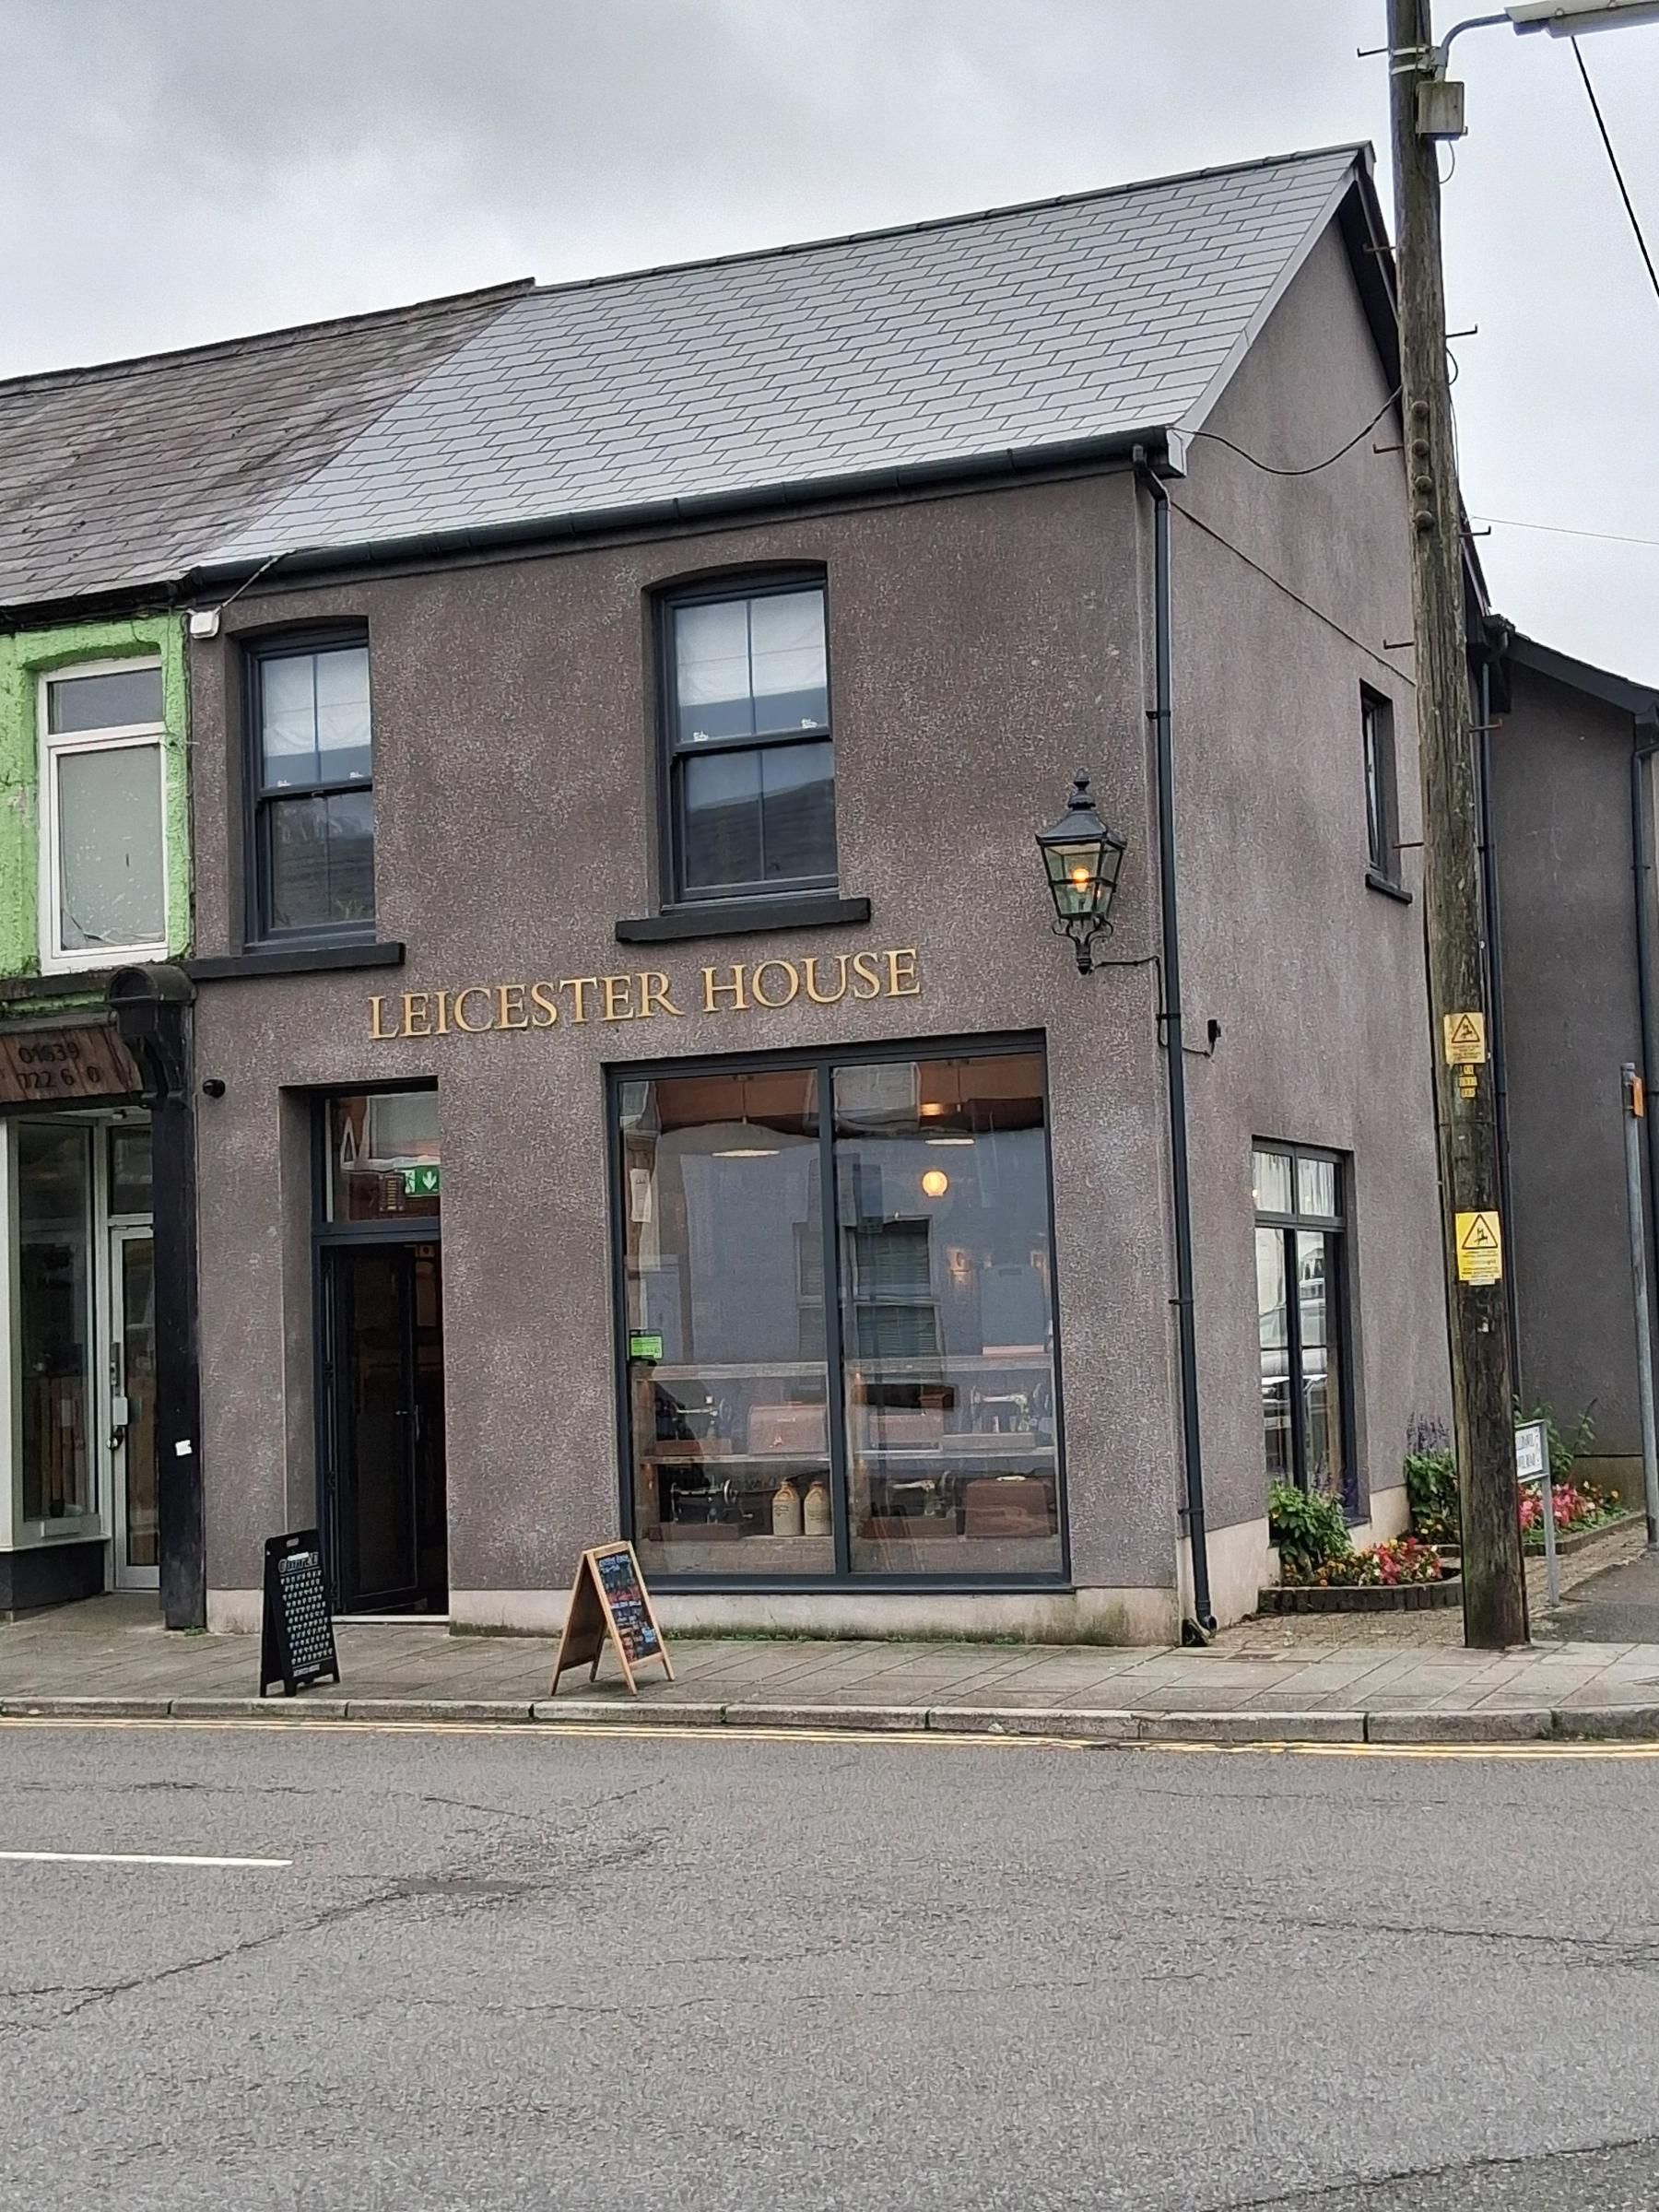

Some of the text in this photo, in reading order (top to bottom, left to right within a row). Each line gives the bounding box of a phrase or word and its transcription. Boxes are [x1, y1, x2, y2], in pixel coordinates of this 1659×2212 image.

[369, 948, 921, 1040] LEICESTER HOUSE
[18, 1041, 80, 1065] 01639
